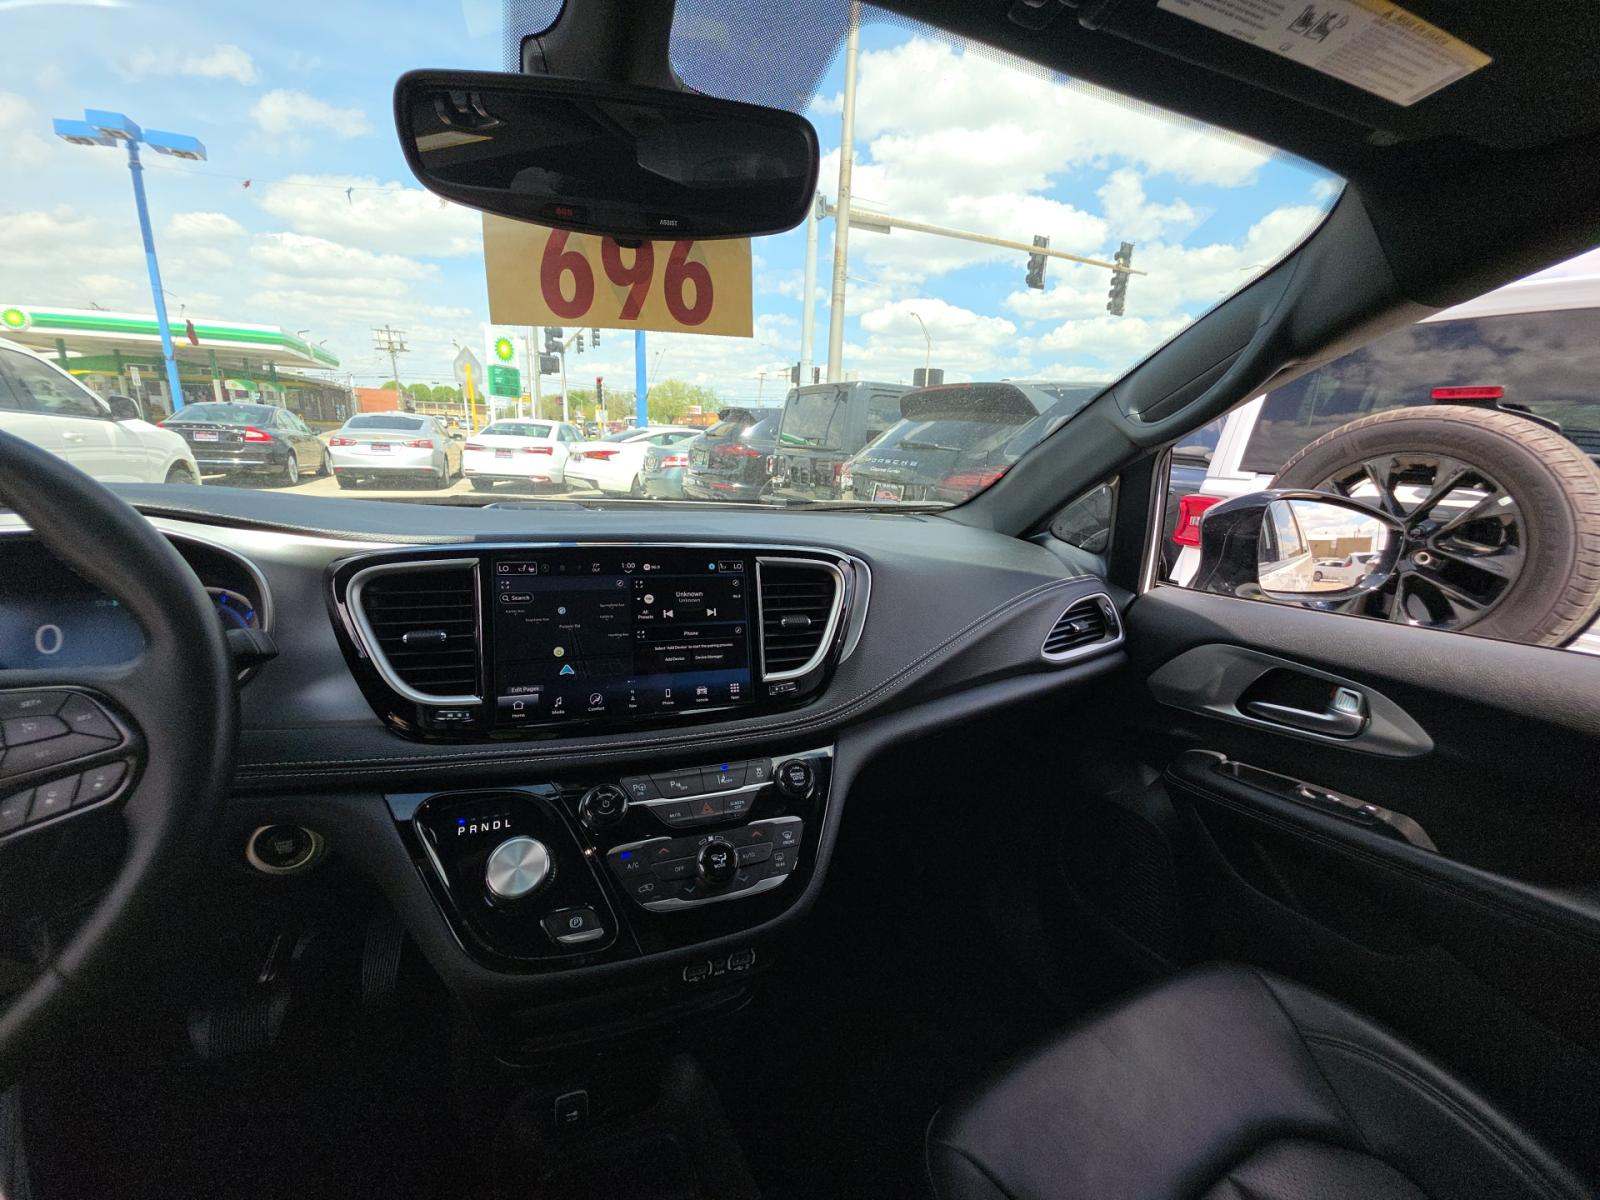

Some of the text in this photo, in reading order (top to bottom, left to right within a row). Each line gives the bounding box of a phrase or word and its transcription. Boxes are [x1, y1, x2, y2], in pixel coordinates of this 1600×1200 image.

[540, 227, 714, 326] 696
[34, 624, 64, 655] 0
[627, 861, 640, 870] A/C
